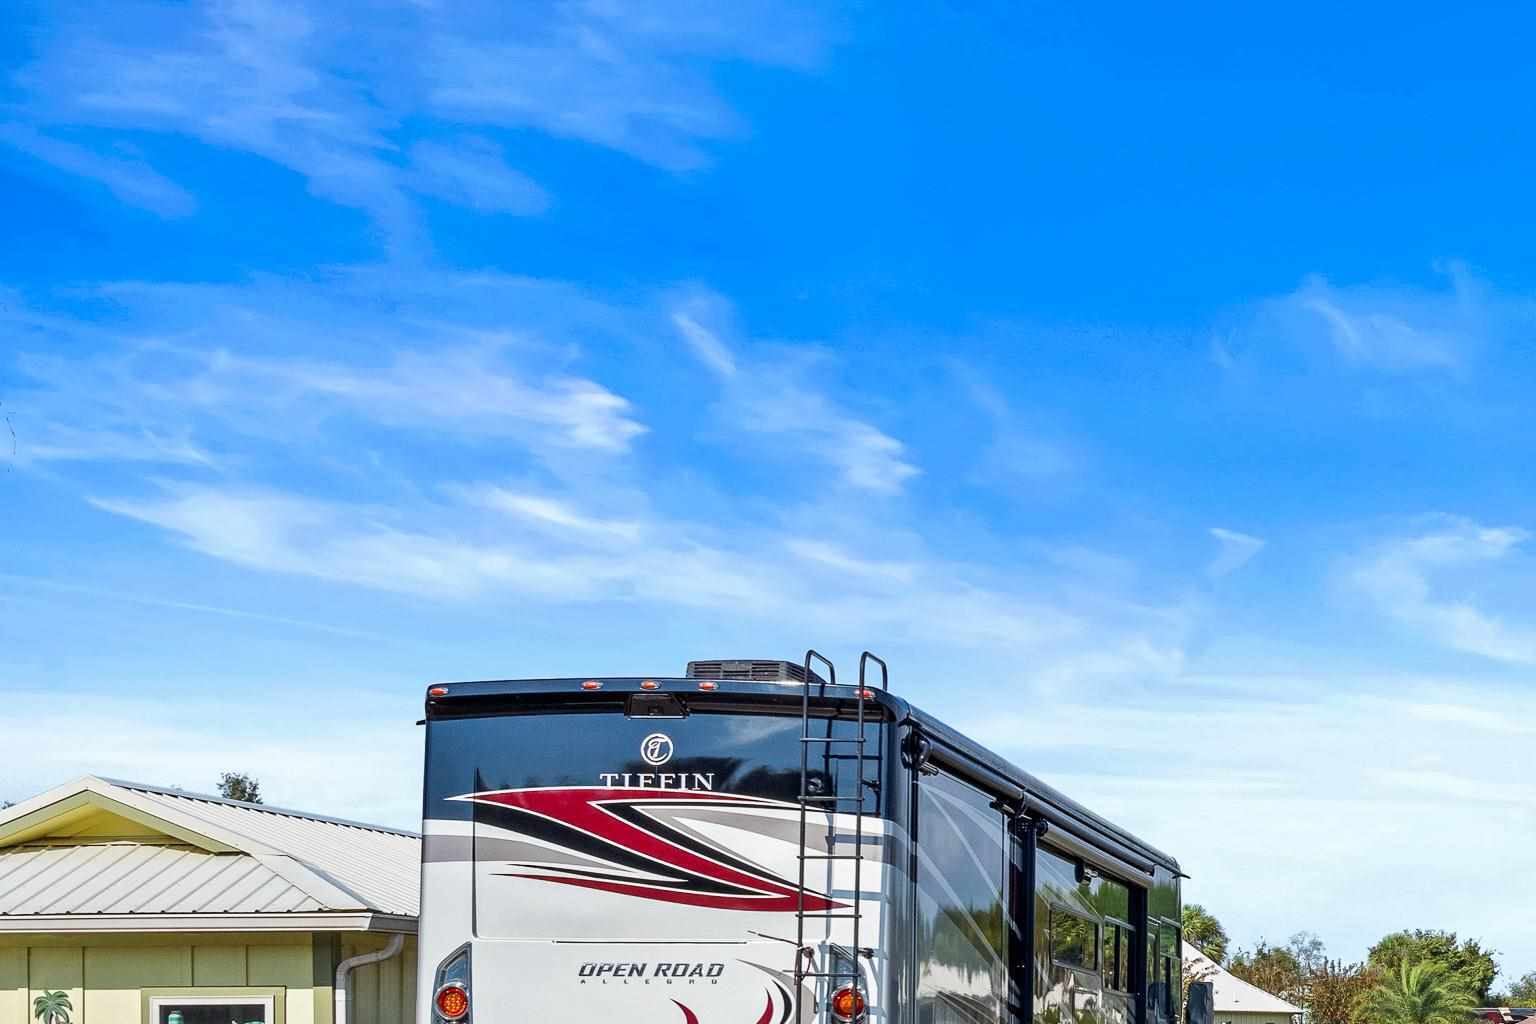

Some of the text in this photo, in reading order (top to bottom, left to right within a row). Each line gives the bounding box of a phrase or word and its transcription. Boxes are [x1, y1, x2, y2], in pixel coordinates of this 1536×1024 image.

[600, 773, 715, 790] TIFFIN
[579, 962, 725, 977] OPEN ROAD
